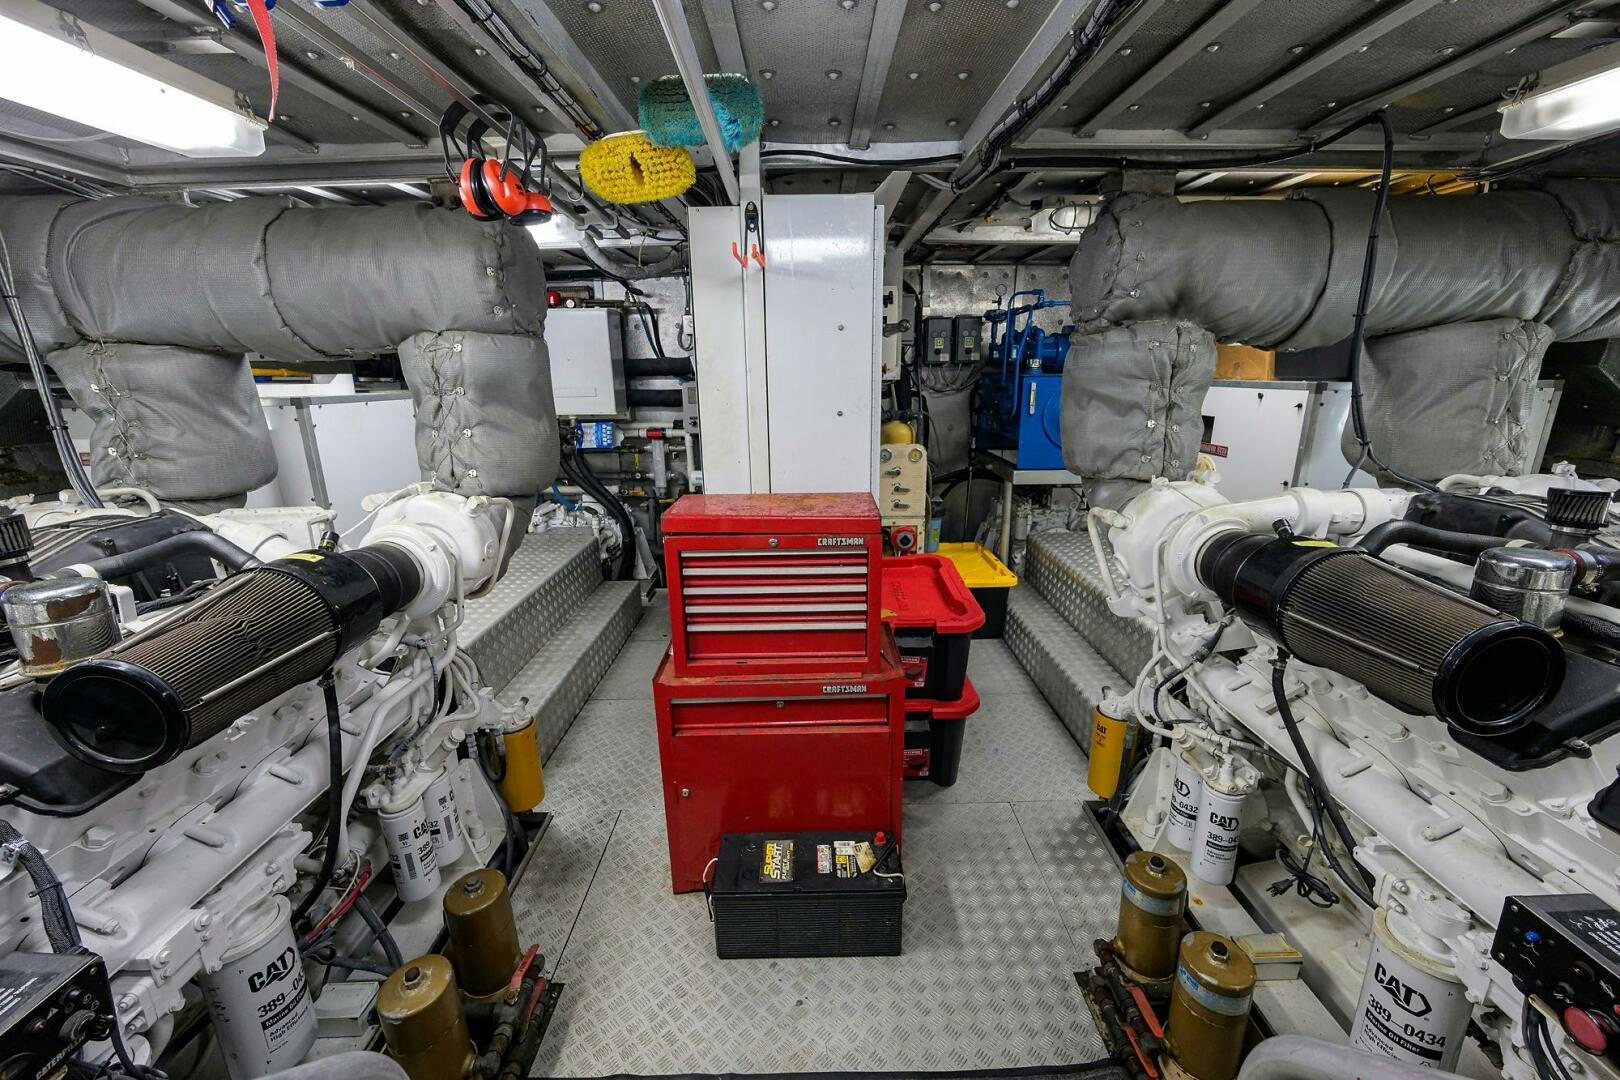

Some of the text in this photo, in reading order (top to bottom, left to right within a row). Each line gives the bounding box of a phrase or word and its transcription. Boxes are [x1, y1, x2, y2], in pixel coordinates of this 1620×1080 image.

[817, 537, 865, 546] CRAFTSMAN
[822, 684, 867, 694] CRAFTSMAN
[1210, 812, 1237, 830] CAT
[417, 841, 430, 854] 389
[764, 843, 774, 875] SUPER
[771, 843, 782, 879] START
[248, 949, 292, 993] CAT
[1375, 962, 1427, 1013] CAT
[1368, 993, 1447, 1048] 389-0434
[1388, 1032, 1399, 1042] Oil
